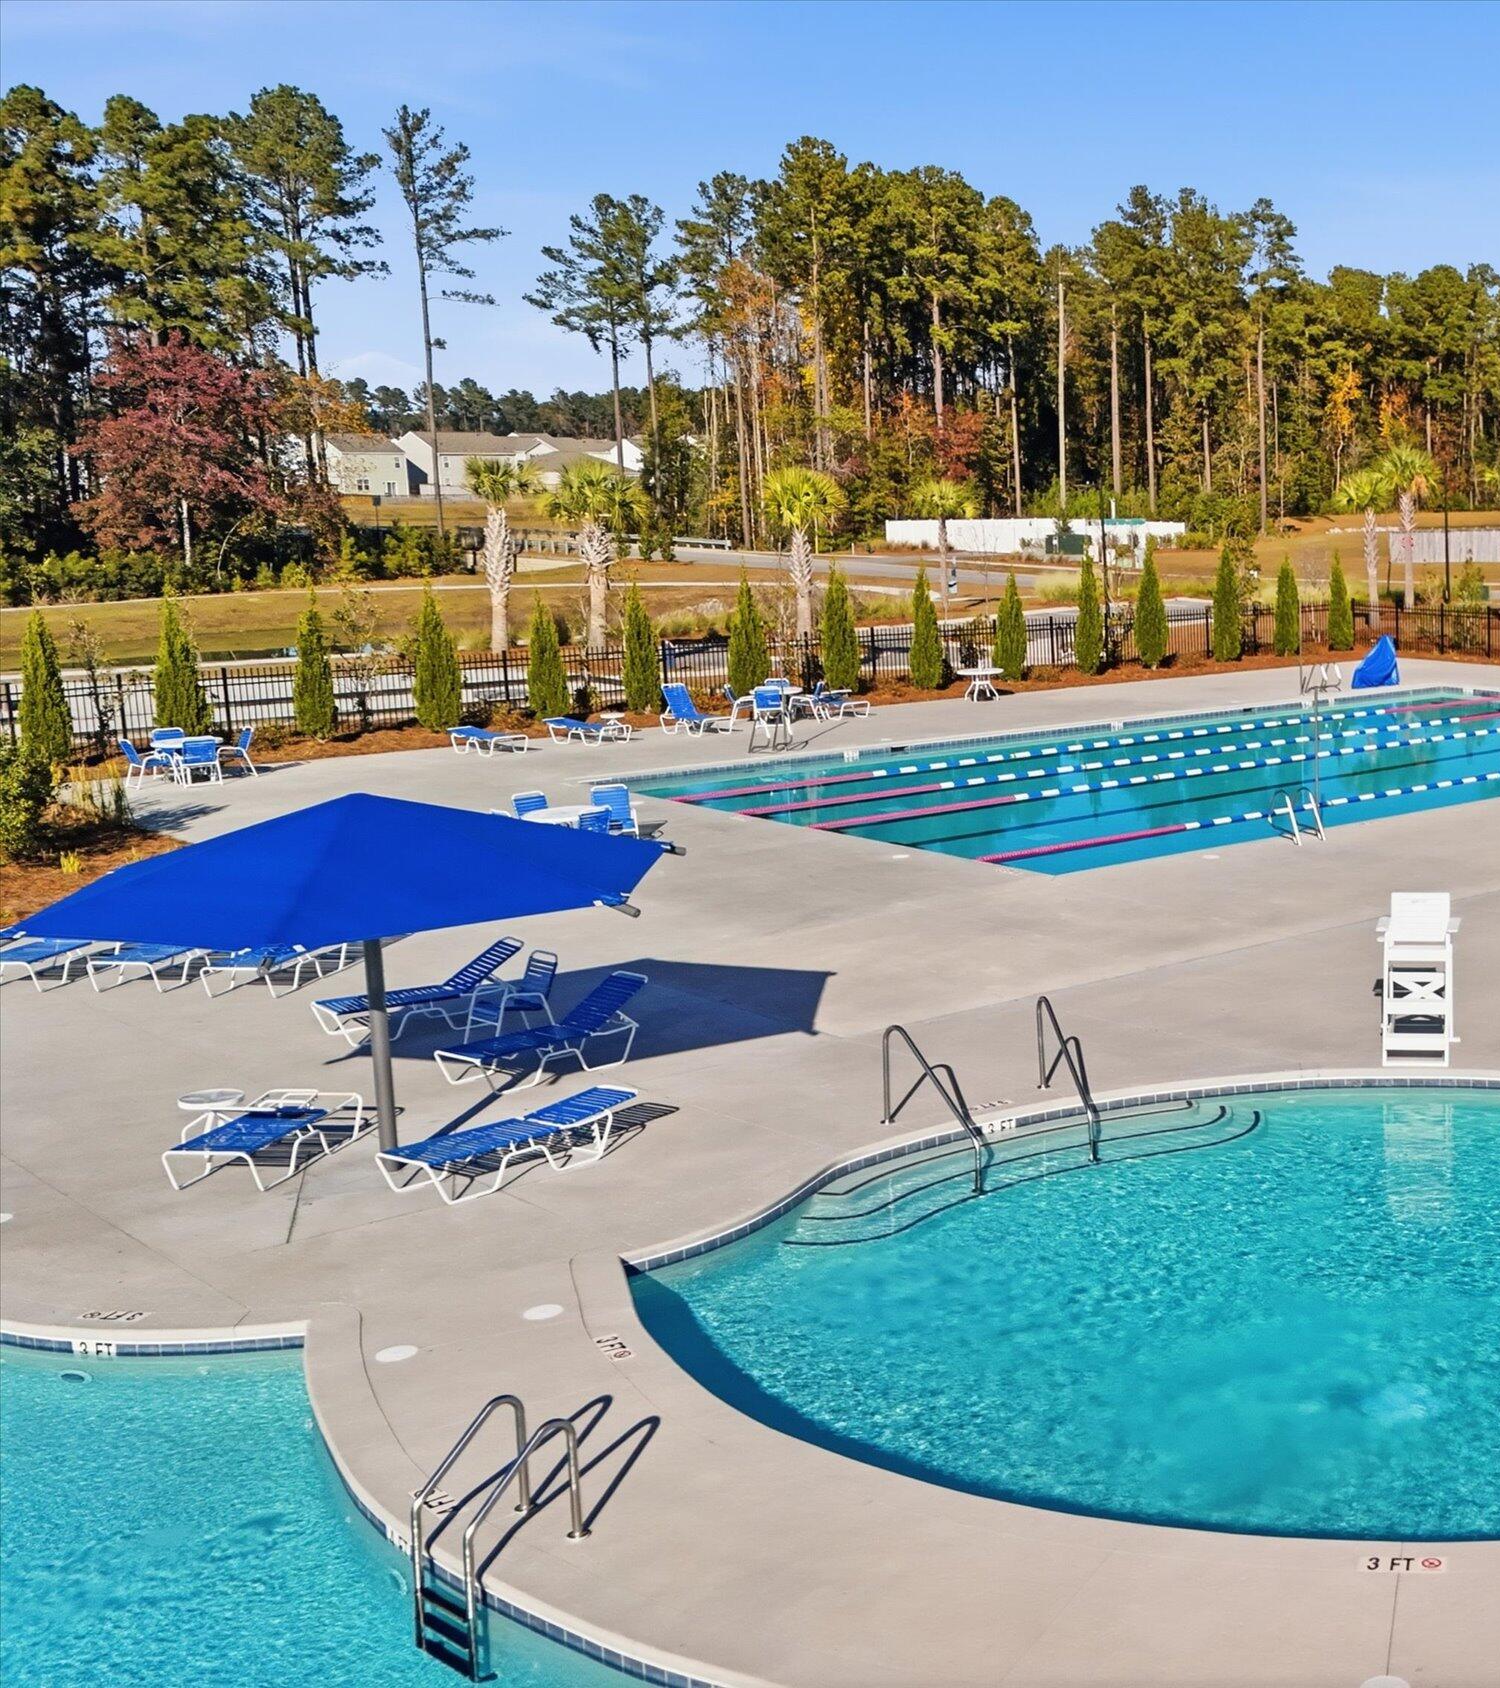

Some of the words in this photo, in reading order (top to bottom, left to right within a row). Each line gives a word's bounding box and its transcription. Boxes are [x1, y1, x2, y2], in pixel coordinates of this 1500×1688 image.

[79, 1341, 89, 1355] 3
[95, 1342, 113, 1356] FT
[1366, 1556, 1381, 1571] 3
[1389, 1557, 1416, 1571] FT
